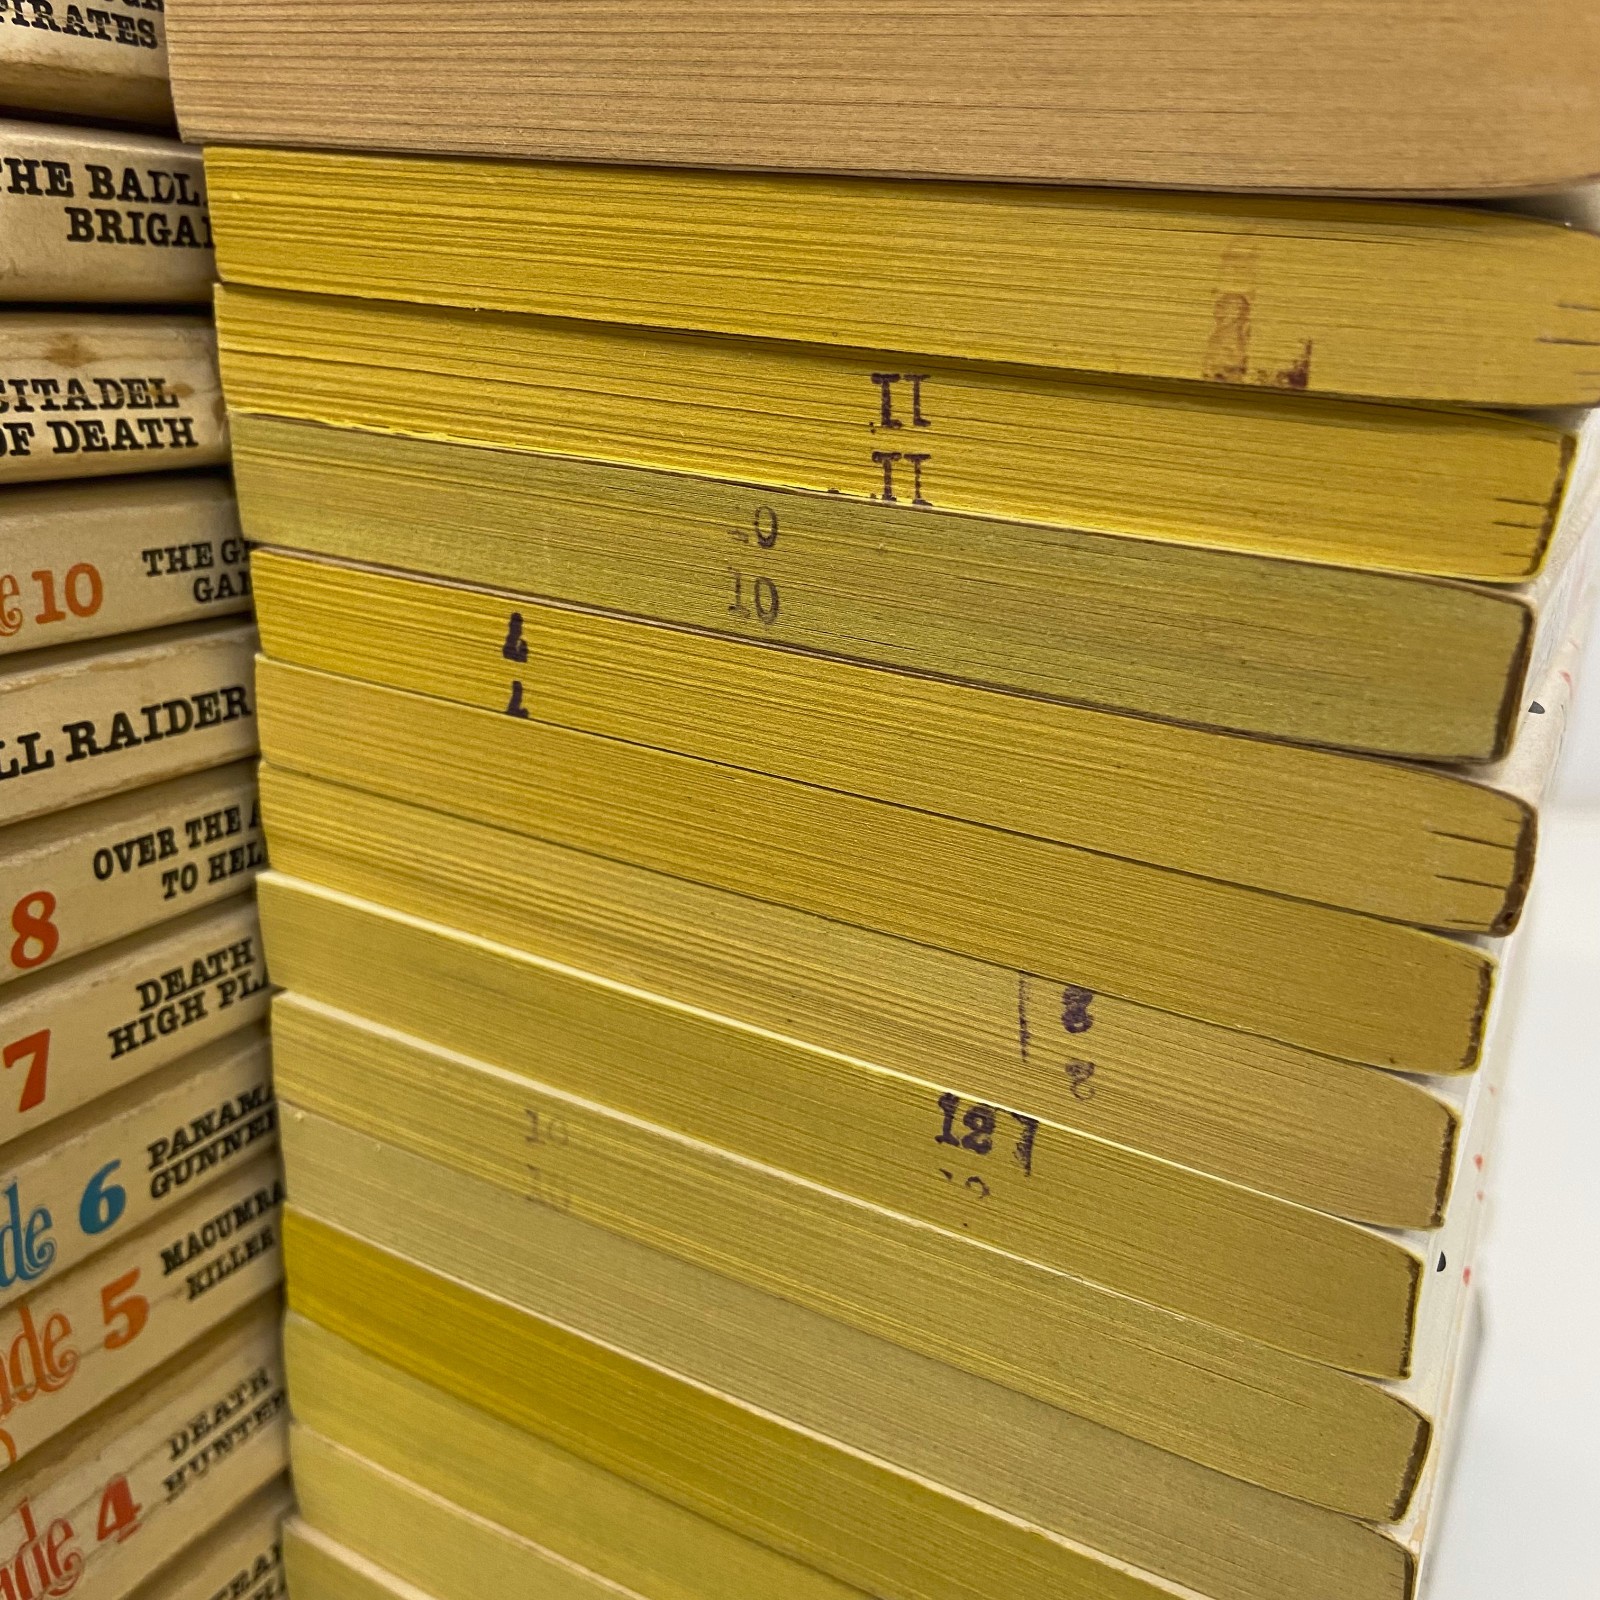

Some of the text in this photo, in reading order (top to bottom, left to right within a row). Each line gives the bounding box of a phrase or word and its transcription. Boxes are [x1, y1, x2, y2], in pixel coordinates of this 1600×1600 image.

[0, 157, 209, 207] HE BADL
[46, 417, 199, 455] DEATH
[31, 562, 104, 625] 10
[142, 541, 214, 578] THE
[62, 684, 253, 763] RAIDER
[92, 826, 178, 882] OVER
[185, 804, 241, 849] THE
[162, 861, 199, 900] TO
[10, 890, 60, 970] 8
[135, 936, 256, 1013] DEATH
[107, 990, 209, 1060] HIGH
[2, 1028, 51, 1114] 7
[78, 1158, 127, 1236] 6
[186, 1223, 276, 1301] KILLER
[100, 1266, 150, 1350] 5
[168, 1367, 270, 1462] DEATH
[96, 1472, 143, 1543] 4
